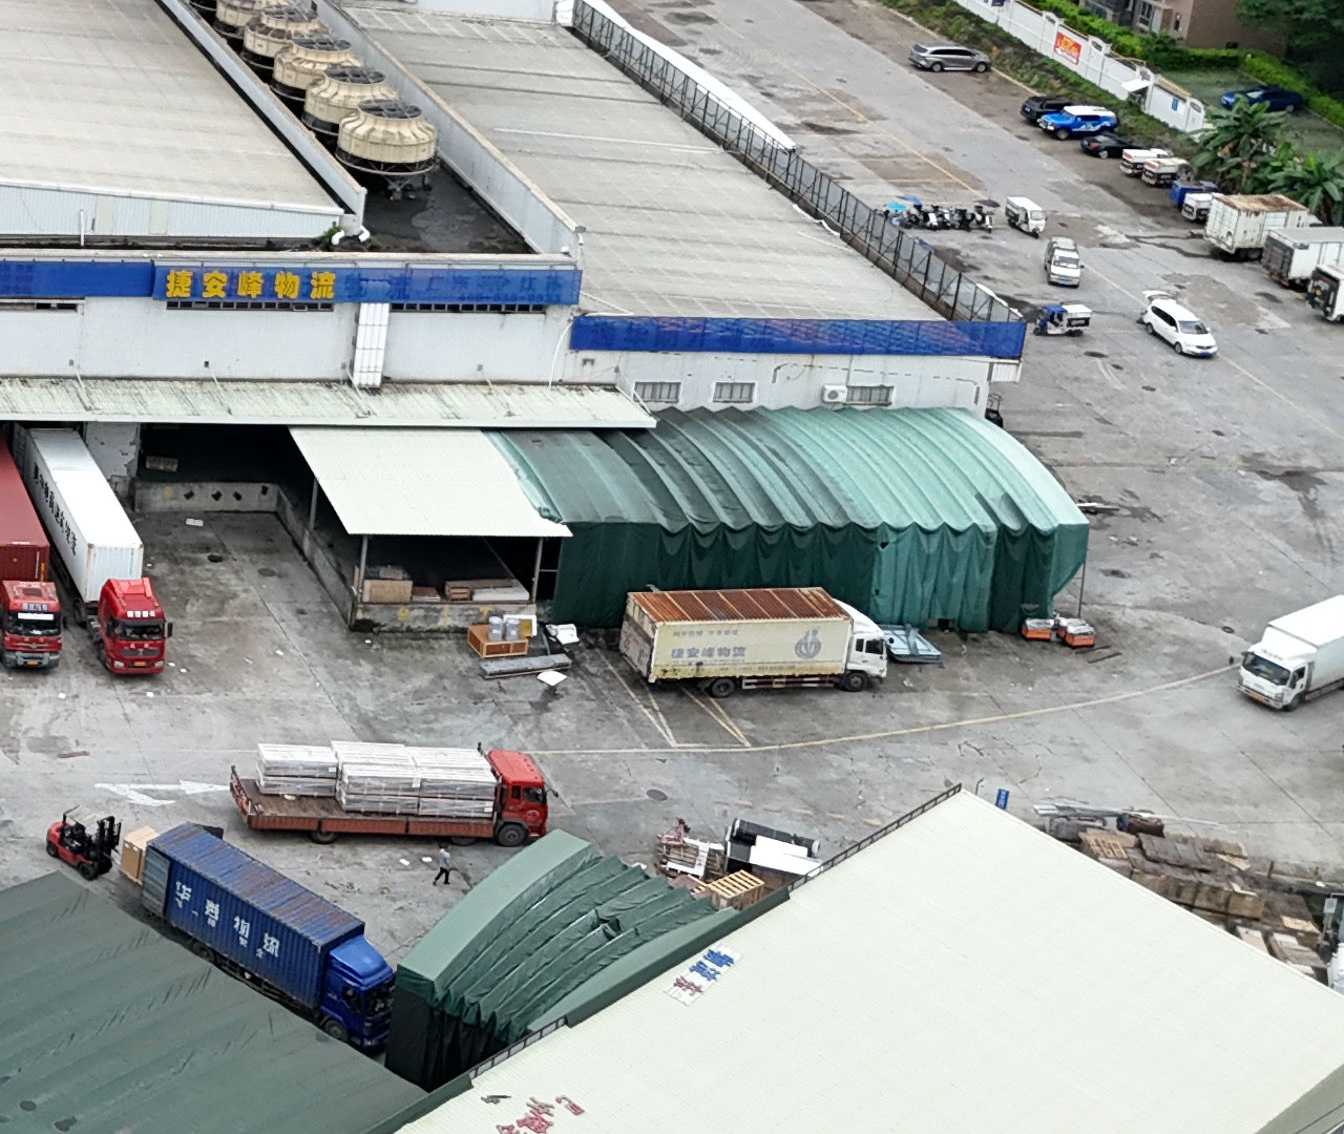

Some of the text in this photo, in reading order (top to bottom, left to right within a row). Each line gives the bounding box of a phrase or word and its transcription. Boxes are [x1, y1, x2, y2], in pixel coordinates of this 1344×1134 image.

[165, 269, 336, 299] 捷安峰物流
